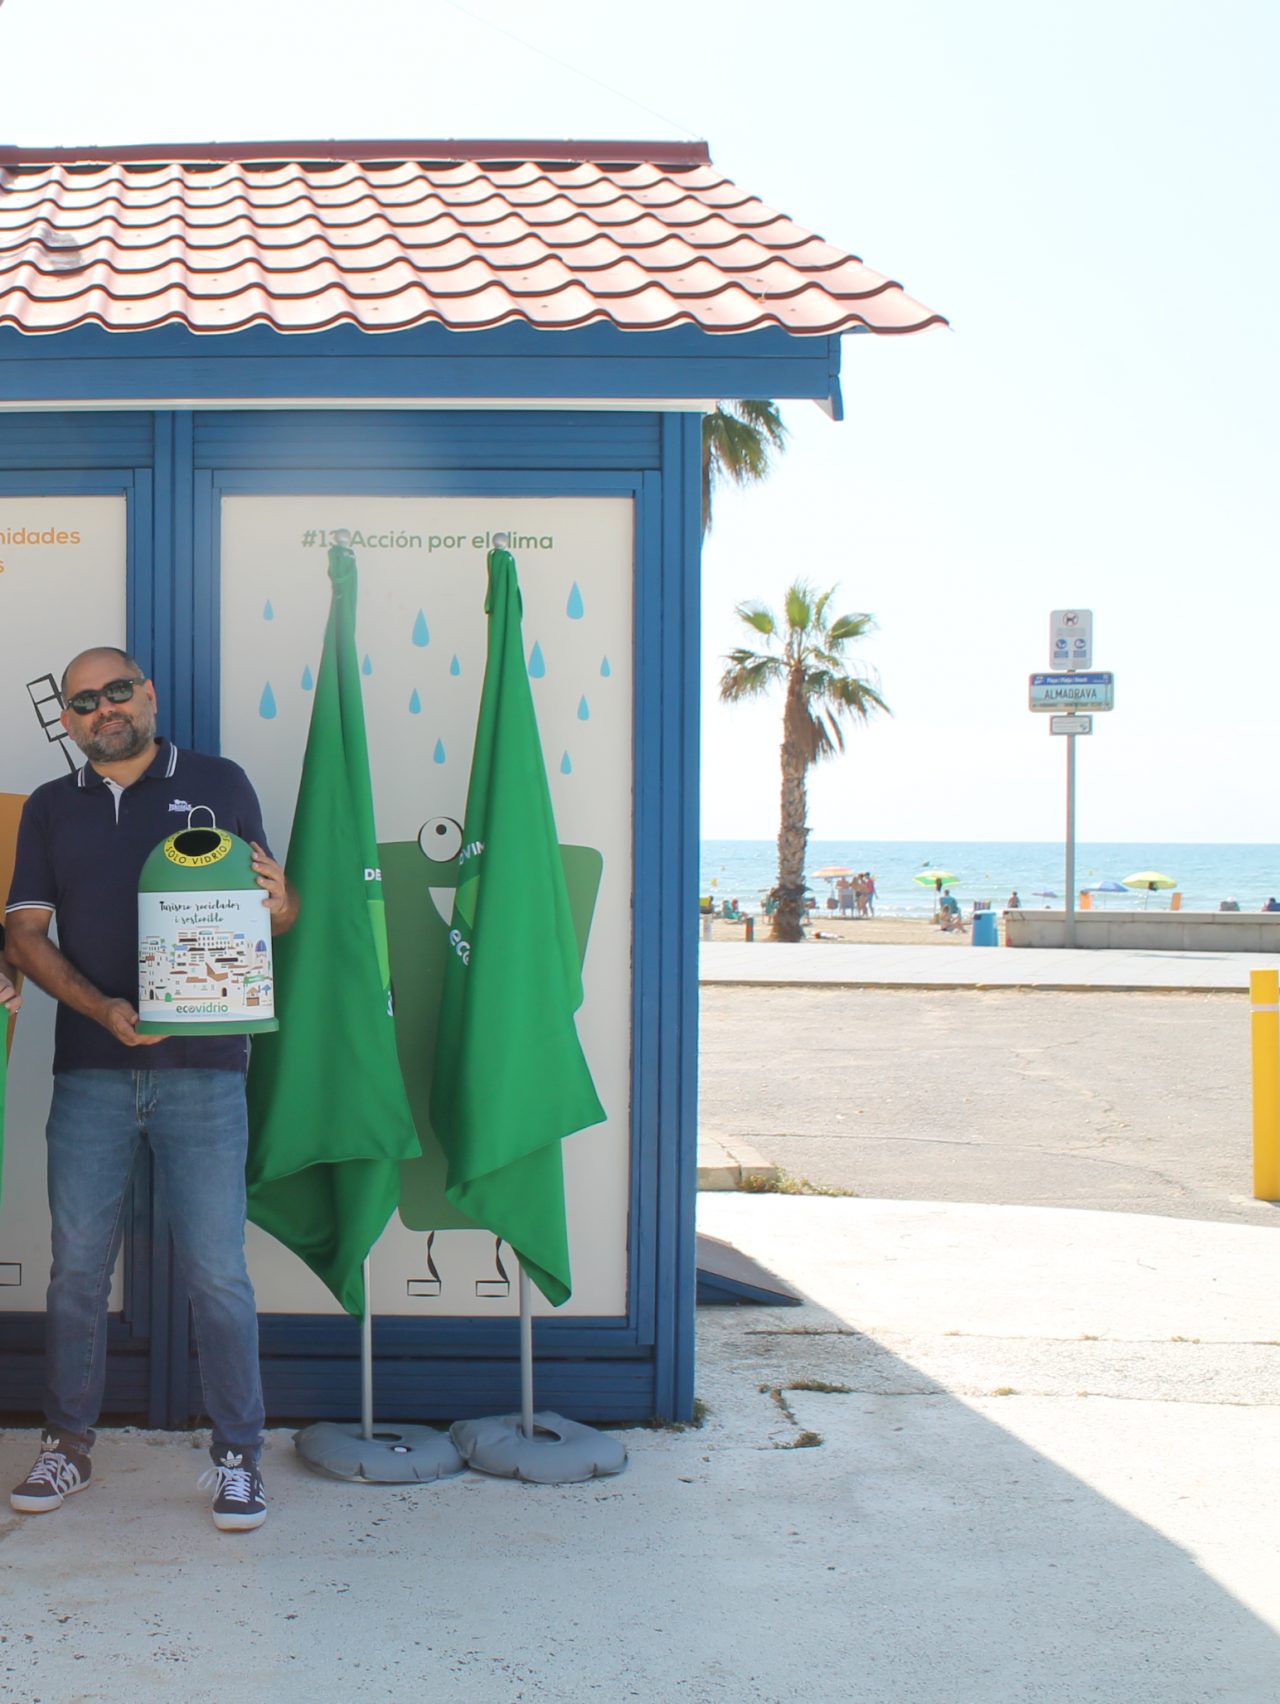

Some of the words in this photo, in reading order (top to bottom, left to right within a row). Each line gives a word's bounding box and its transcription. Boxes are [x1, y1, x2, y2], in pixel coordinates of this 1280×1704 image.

[349, 530, 422, 548] Acción
[428, 534, 466, 552] por
[472, 531, 490, 548] el
[493, 531, 553, 549] lima
[166, 846, 187, 864] SOLO
[192, 845, 227, 865] VIDRIO
[176, 1002, 228, 1013] ecovidrio
